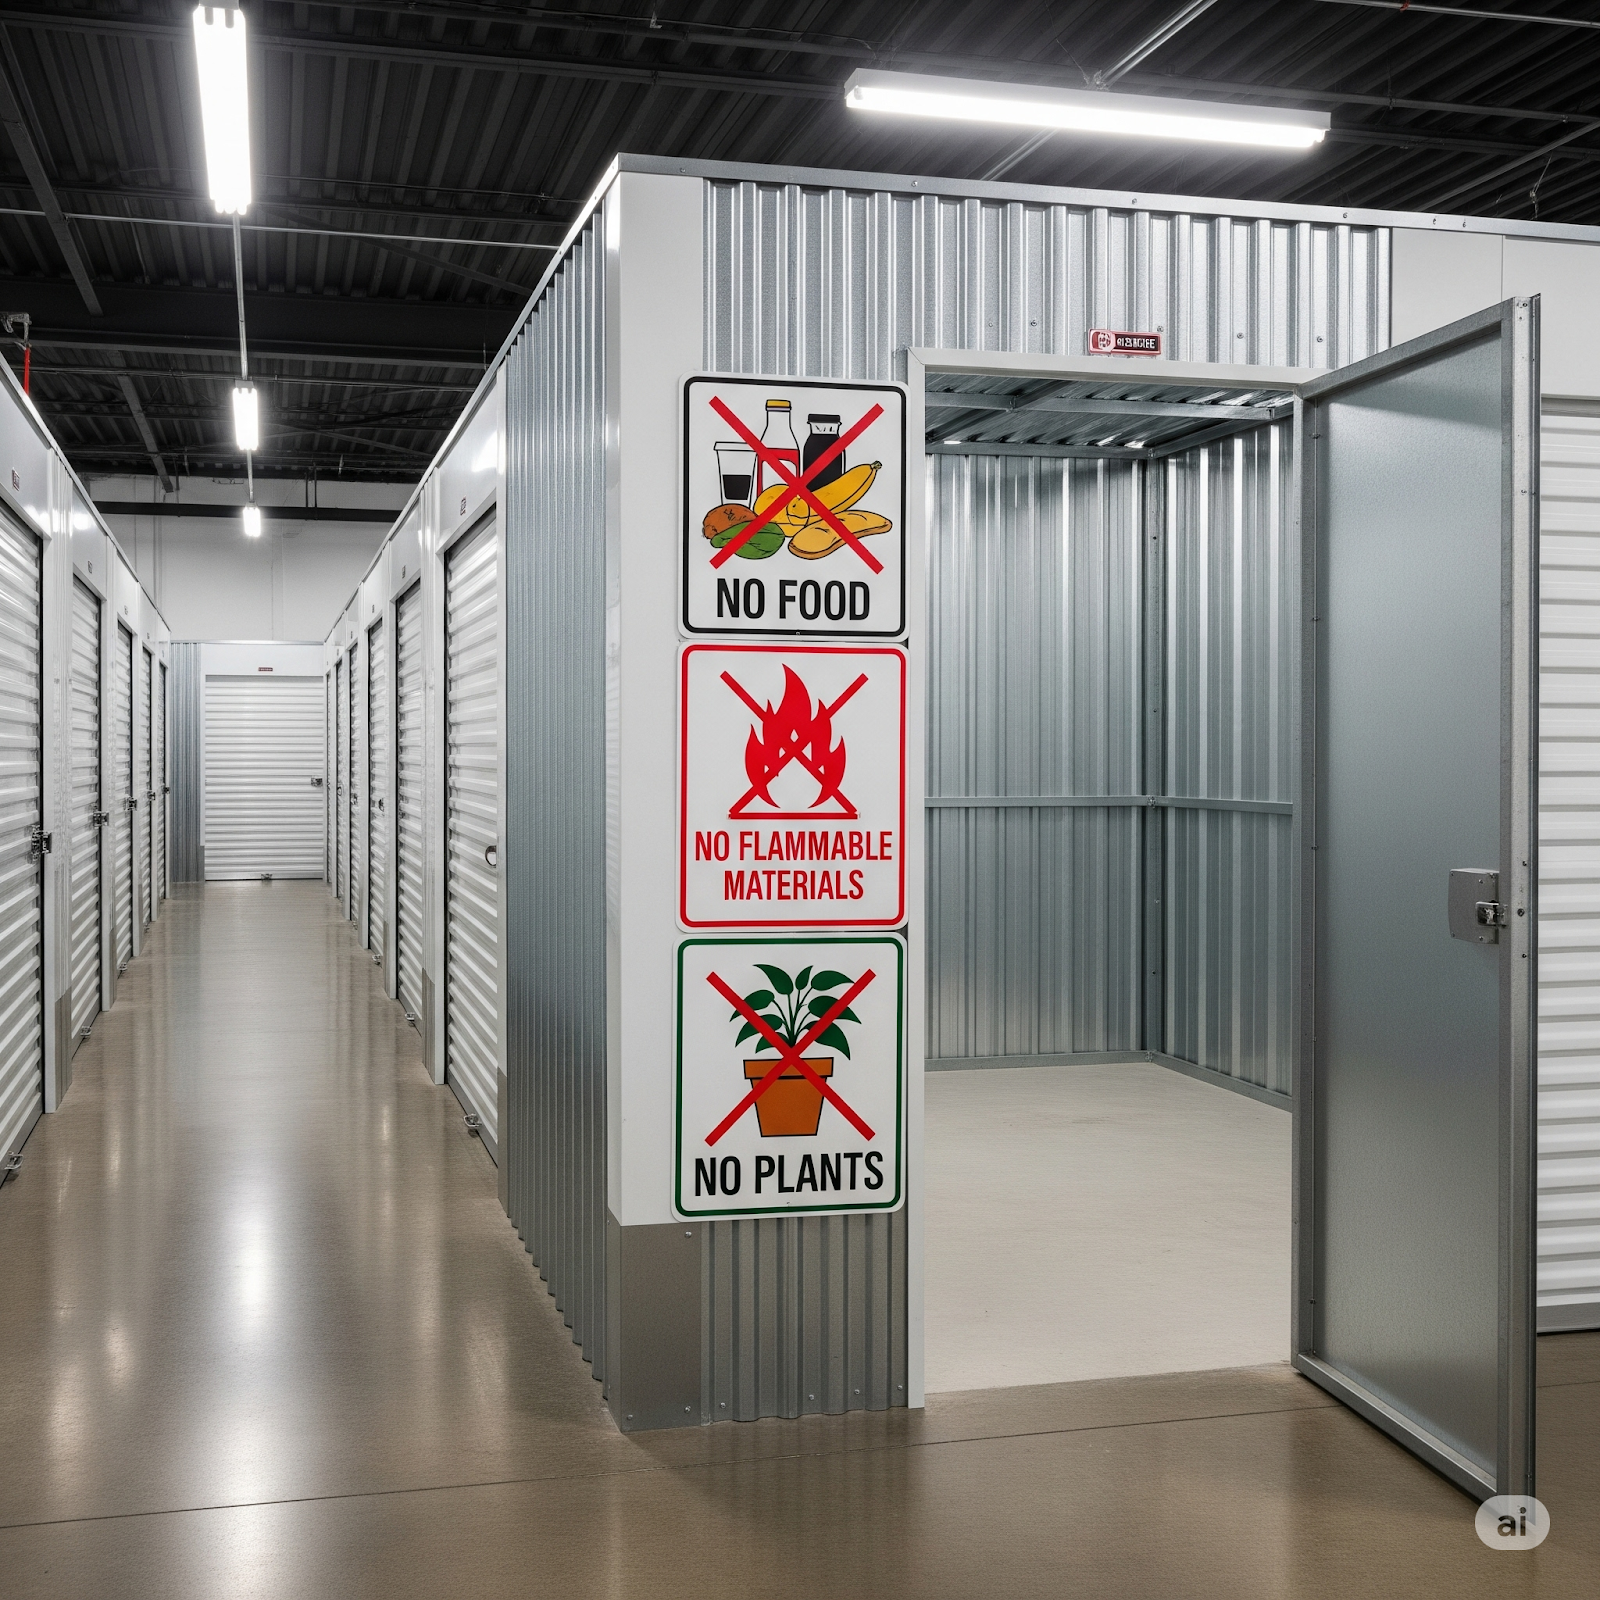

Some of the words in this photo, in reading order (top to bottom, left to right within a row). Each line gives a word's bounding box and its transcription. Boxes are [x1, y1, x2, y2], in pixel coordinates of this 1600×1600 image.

[717, 578, 765, 619] NO
[779, 580, 870, 620] FOOD
[695, 830, 730, 861] NO
[740, 831, 893, 861] FLAMMABLE
[724, 869, 864, 900] MATERIALS
[694, 1156, 741, 1197] NO
[754, 1151, 883, 1194] PLANTS
